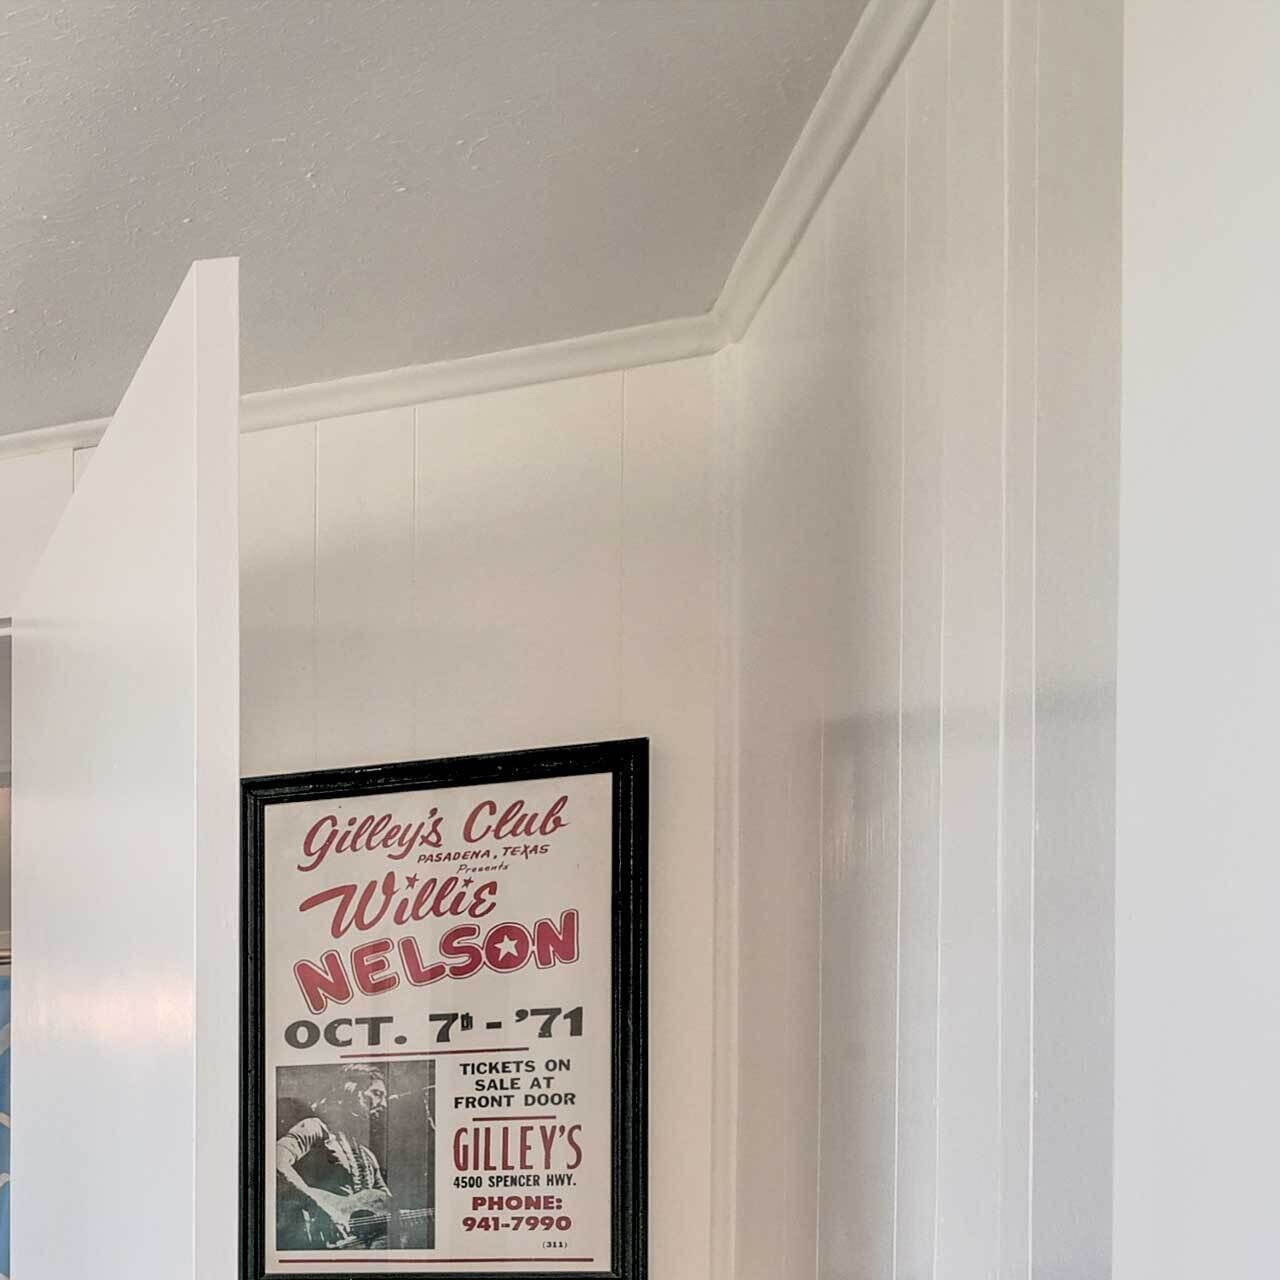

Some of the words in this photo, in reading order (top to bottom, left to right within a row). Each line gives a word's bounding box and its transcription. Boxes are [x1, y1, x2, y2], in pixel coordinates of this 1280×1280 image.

[297, 807, 444, 872] Gilley's
[462, 795, 570, 844] Club
[416, 850, 498, 864] PASADENA,
[502, 844, 550, 859] TEXAS
[455, 863, 509, 875] Presents
[293, 908, 579, 1015] NELSON
[284, 1016, 407, 1049] OCT.
[515, 1006, 584, 1038] '71
[459, 1060, 536, 1075] TICKETS
[544, 1059, 571, 1072] ON
[475, 1077, 521, 1091] SALE
[529, 1076, 555, 1089] AT
[454, 1095, 515, 1109] FRONT
[524, 1092, 576, 1106] DOOR
[453, 1124, 583, 1172] GILLEY'S
[453, 1176, 482, 1189] 4500
[488, 1174, 540, 1187] SPENCER
[546, 1173, 577, 1186] HWY.
[472, 1195, 563, 1211] PHONE:
[462, 1216, 572, 1231] 941-7990
